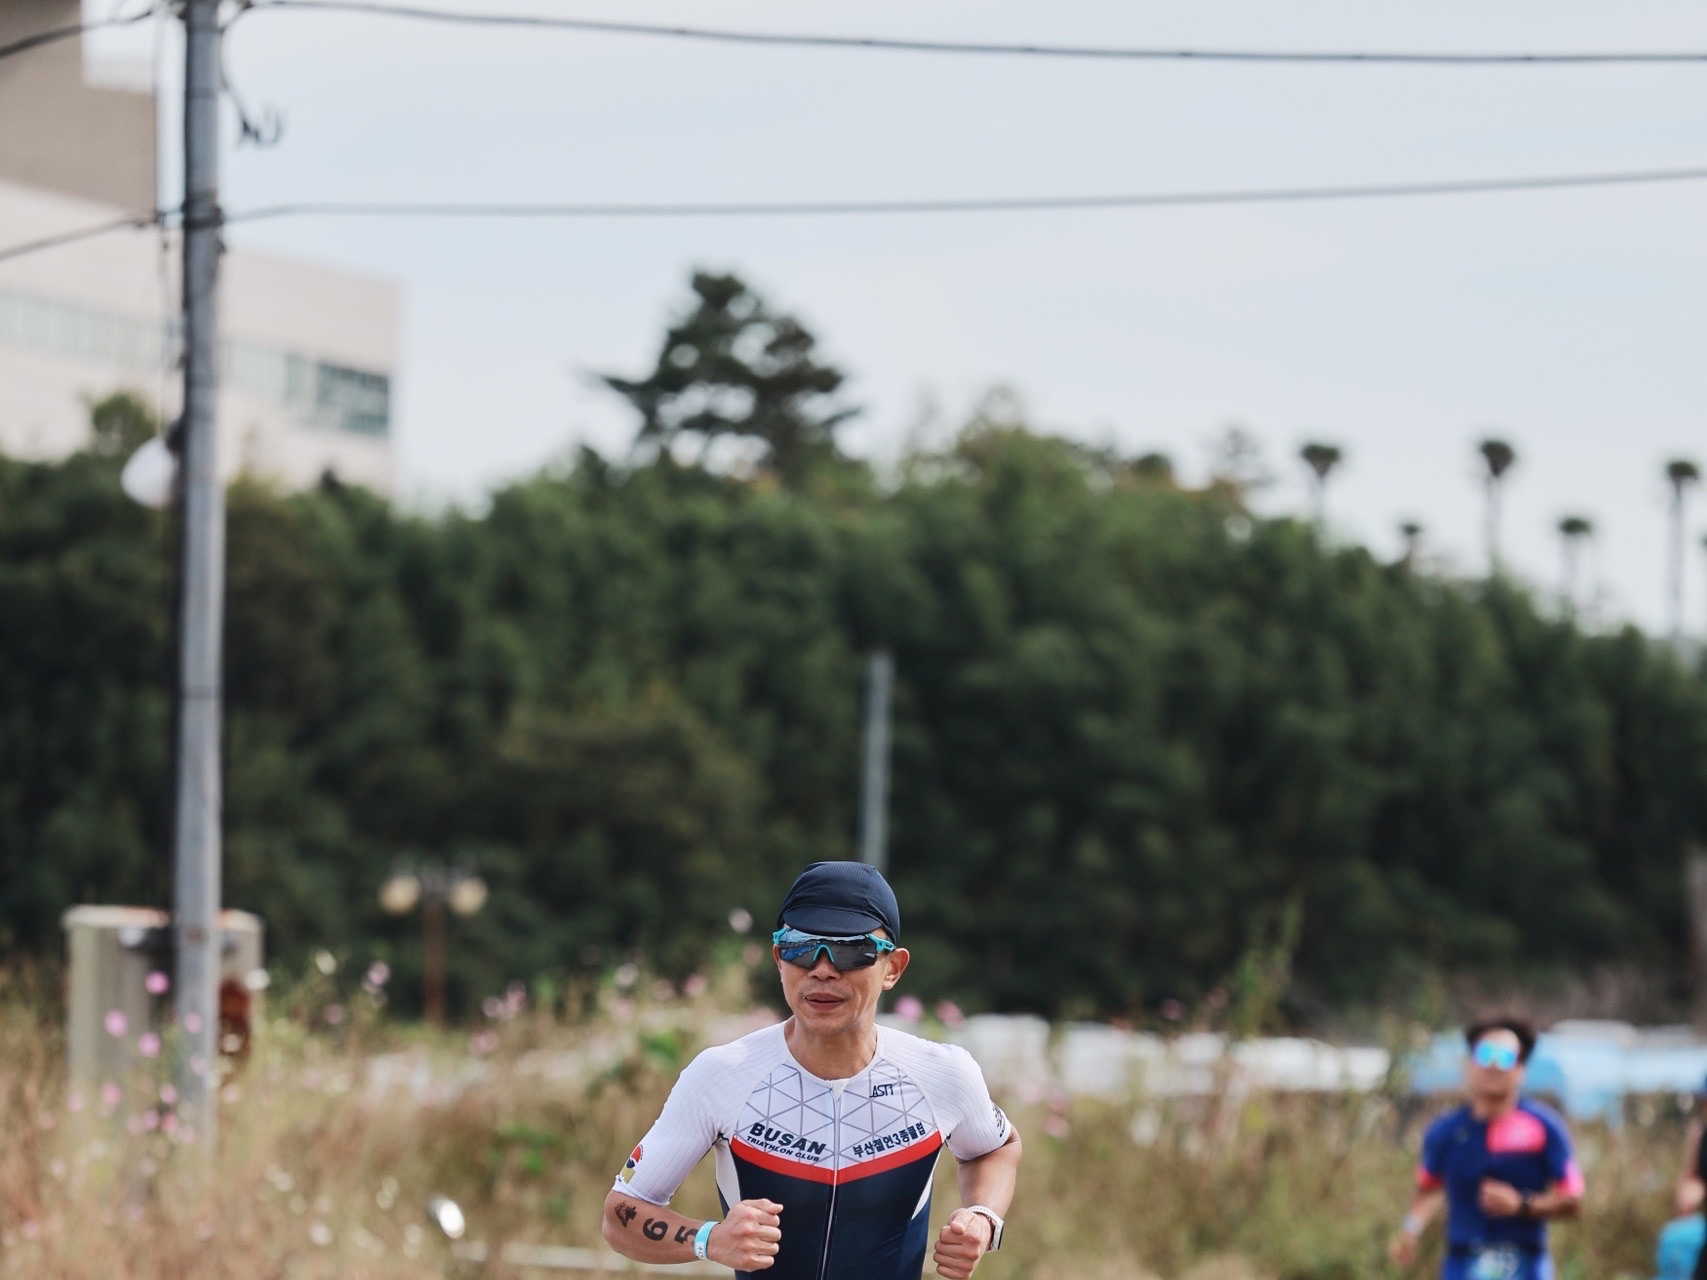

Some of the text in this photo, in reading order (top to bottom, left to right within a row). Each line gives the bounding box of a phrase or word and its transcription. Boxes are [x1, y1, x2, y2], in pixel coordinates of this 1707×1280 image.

[747, 1136, 820, 1162] TRIATHLON CLUB
[749, 1122, 827, 1155] BUSAN
[852, 1122, 926, 1158] 부산철인3종클럽
